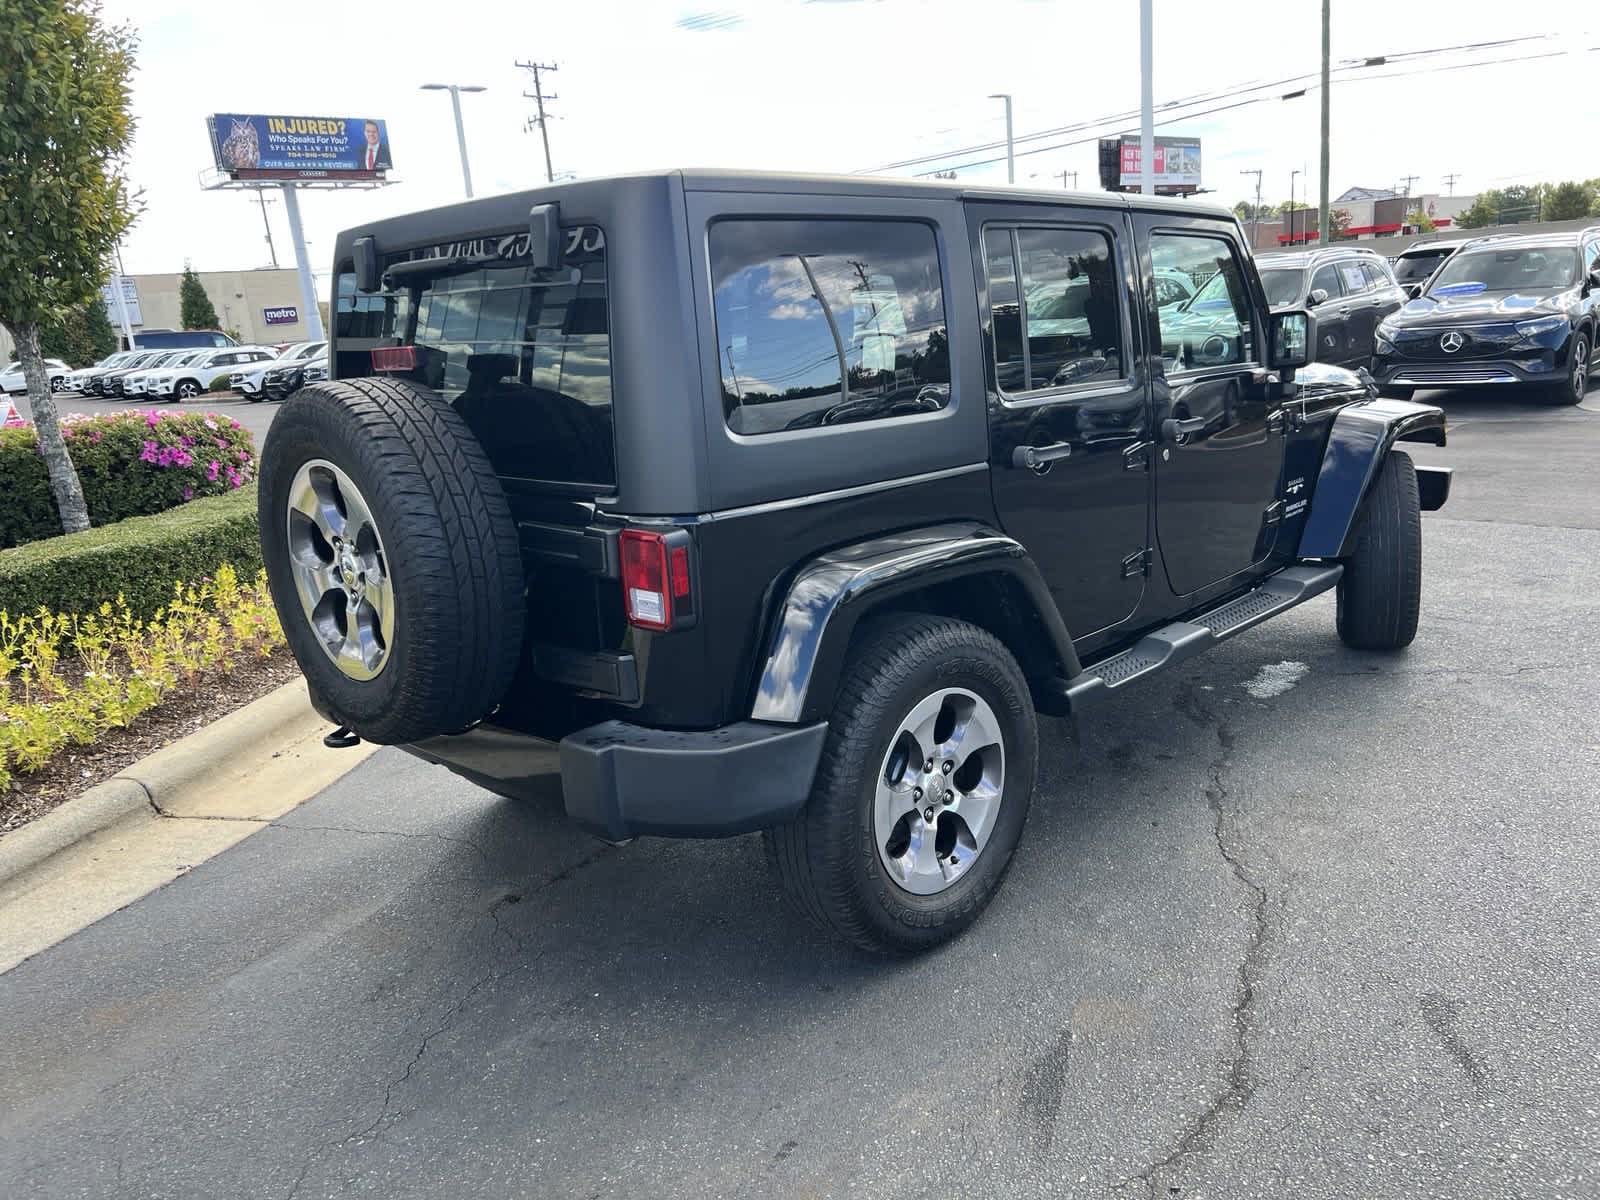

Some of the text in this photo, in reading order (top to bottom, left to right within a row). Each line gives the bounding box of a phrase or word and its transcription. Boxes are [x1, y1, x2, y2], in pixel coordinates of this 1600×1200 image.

[268, 118, 346, 135] INJURED?
[268, 134, 348, 144] Who Speaks For You?
[267, 309, 295, 318] metro
